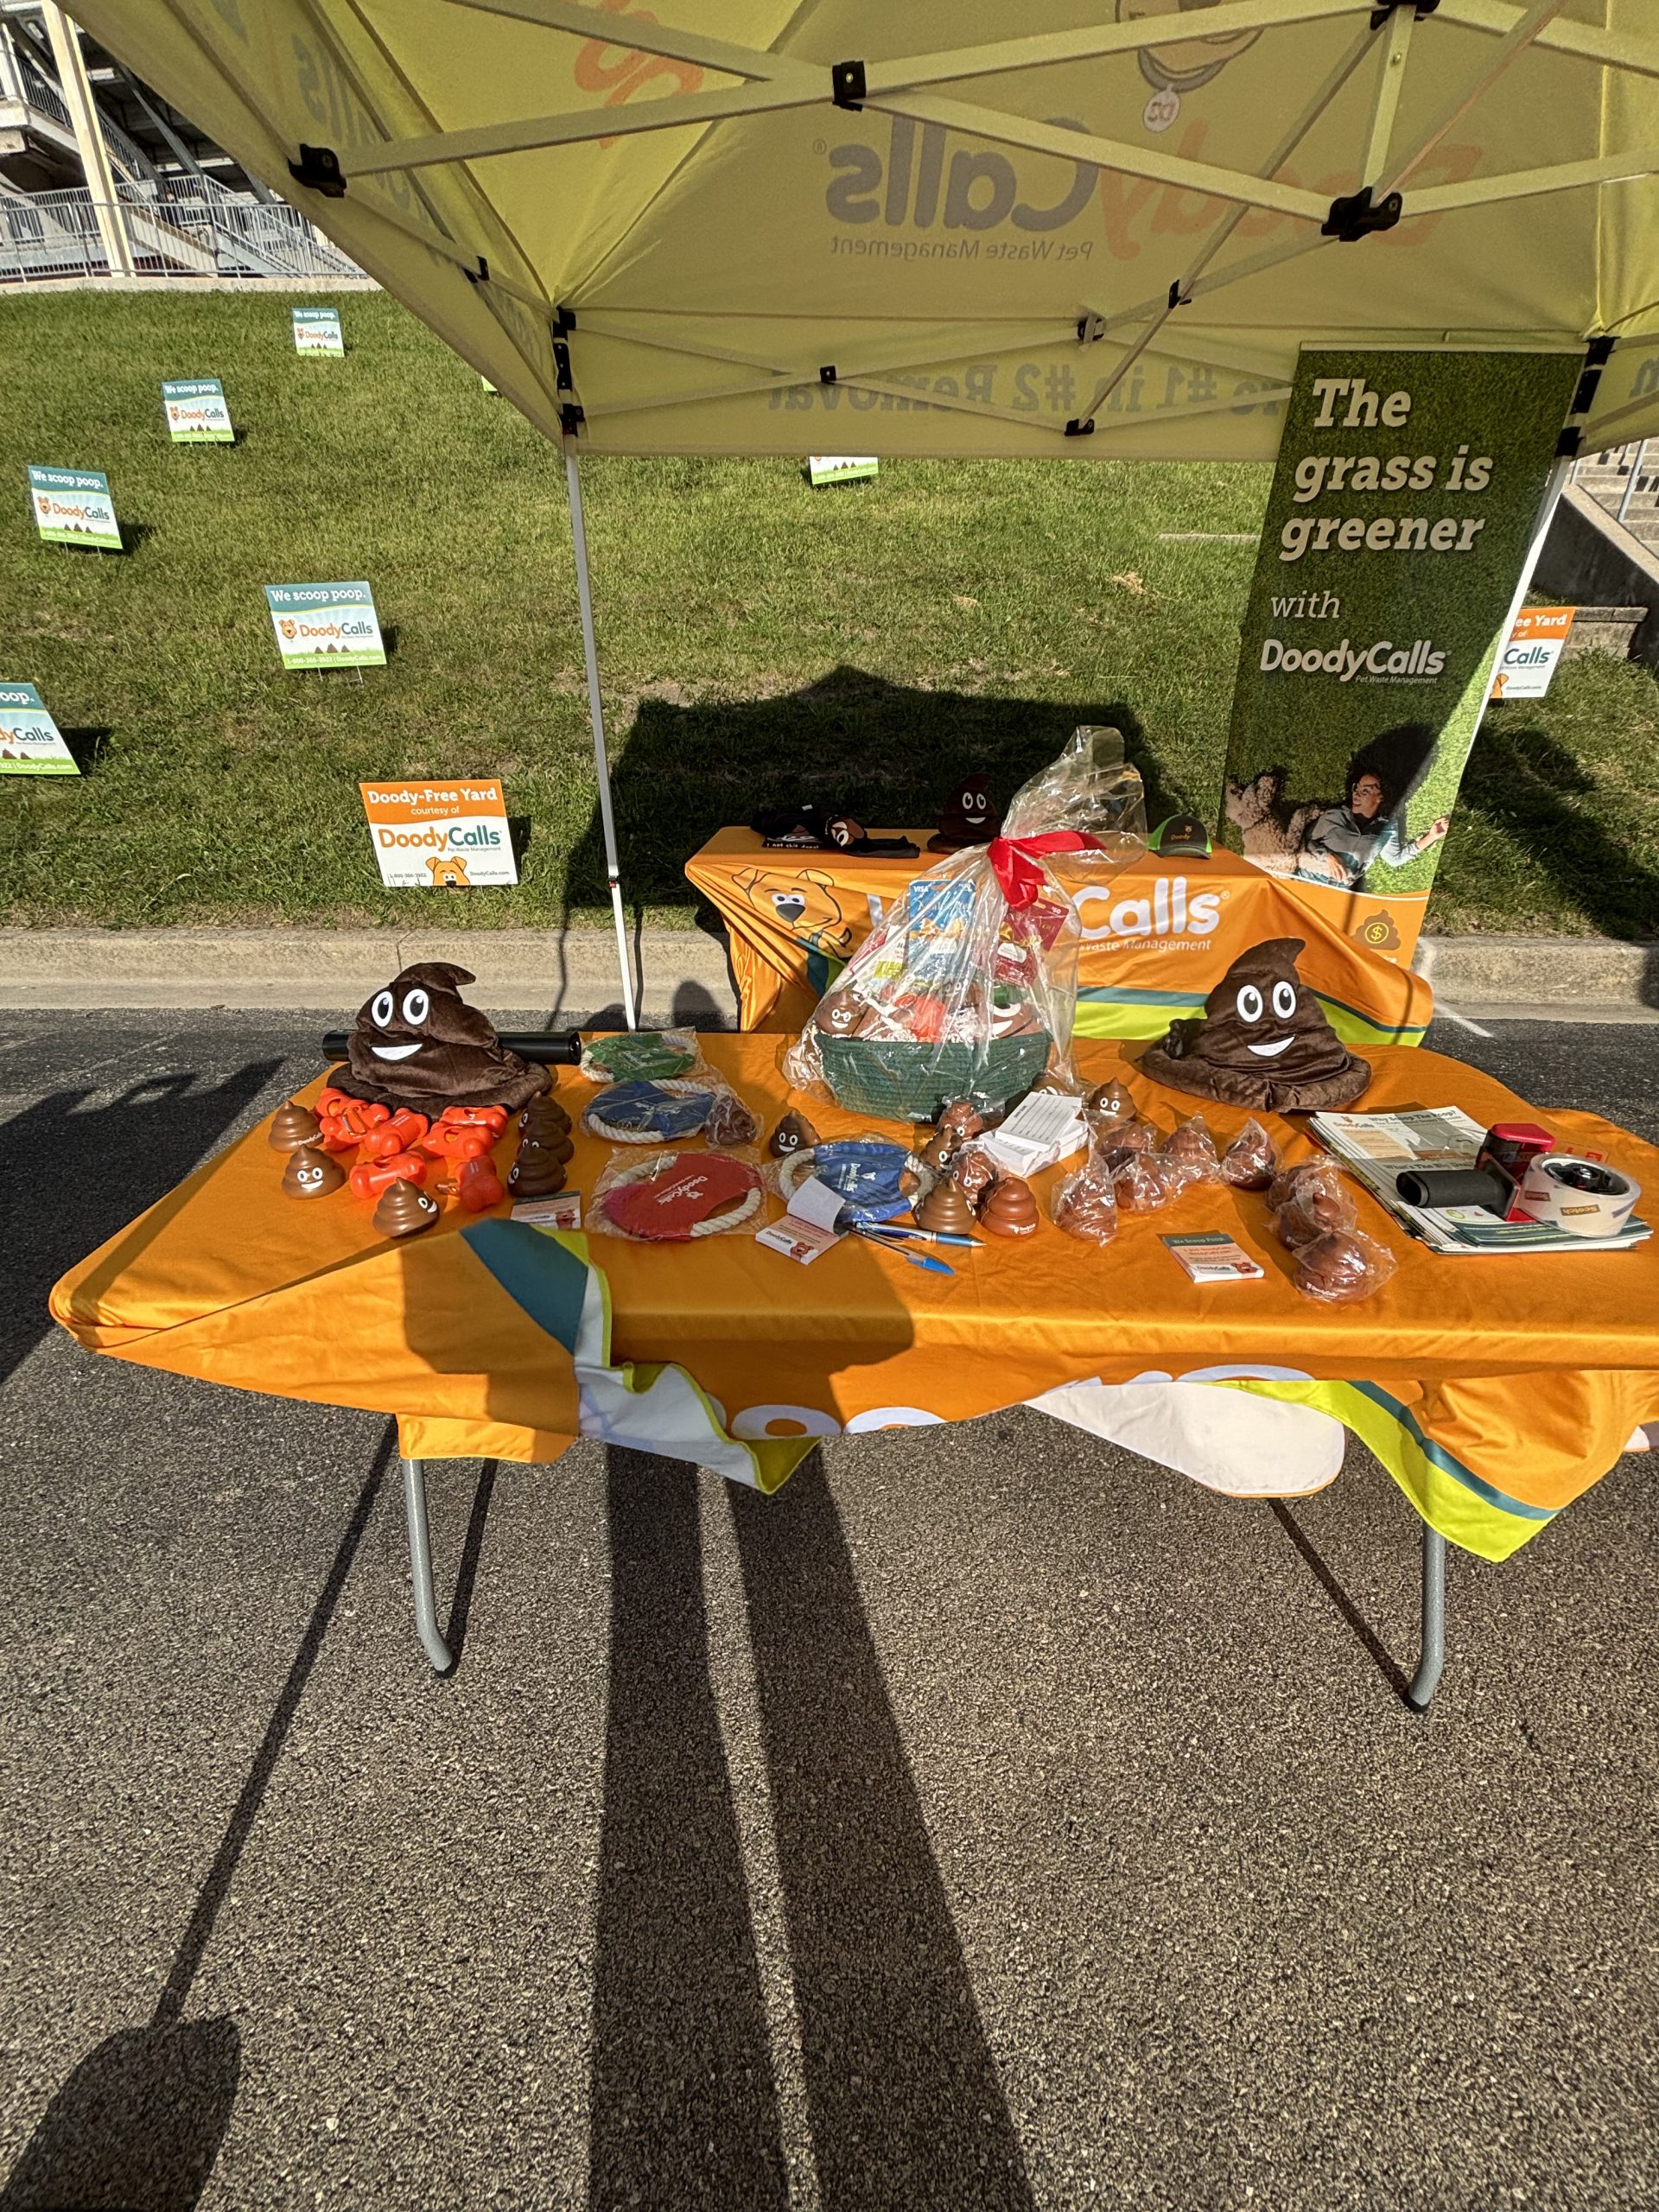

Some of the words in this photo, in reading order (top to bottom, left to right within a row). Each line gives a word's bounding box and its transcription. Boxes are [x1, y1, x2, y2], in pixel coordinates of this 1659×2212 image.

[305, 331, 339, 340] DoodyCalls
[164, 385, 176, 394] We
[176, 385, 198, 394] scoop
[198, 384, 219, 393] poop.
[1312, 378, 1411, 429] The
[181, 408, 225, 421] DoodyCalls
[31, 470, 47, 481] We
[48, 474, 75, 486] scoop
[75, 476, 104, 490] poop.
[1292, 454, 1436, 503] grass
[1445, 443, 1493, 491] is
[53, 503, 110, 520] DoodyCalls
[1279, 516, 1484, 562] greener
[270, 590, 291, 601] We
[293, 590, 329, 602] scoop
[330, 589, 366, 601] poop.
[1270, 590, 1340, 620] with
[1535, 613, 1567, 626] Yard
[299, 621, 373, 639] DoodyCalls
[1259, 639, 1446, 683] DoodyCalls
[1355, 675, 1369, 683] Pet
[1390, 676, 1438, 685] Management
[367, 790, 458, 805] Doody-Free
[460, 787, 498, 801] Yard
[410, 807, 448, 816] courtesy
[450, 805, 460, 814] of
[378, 824, 501, 852] DoodyCalls
[1123, 939, 1211, 952] Management
[658, 1176, 709, 1205] DoodyCalls
[1562, 1205, 1599, 1215] Scotch
